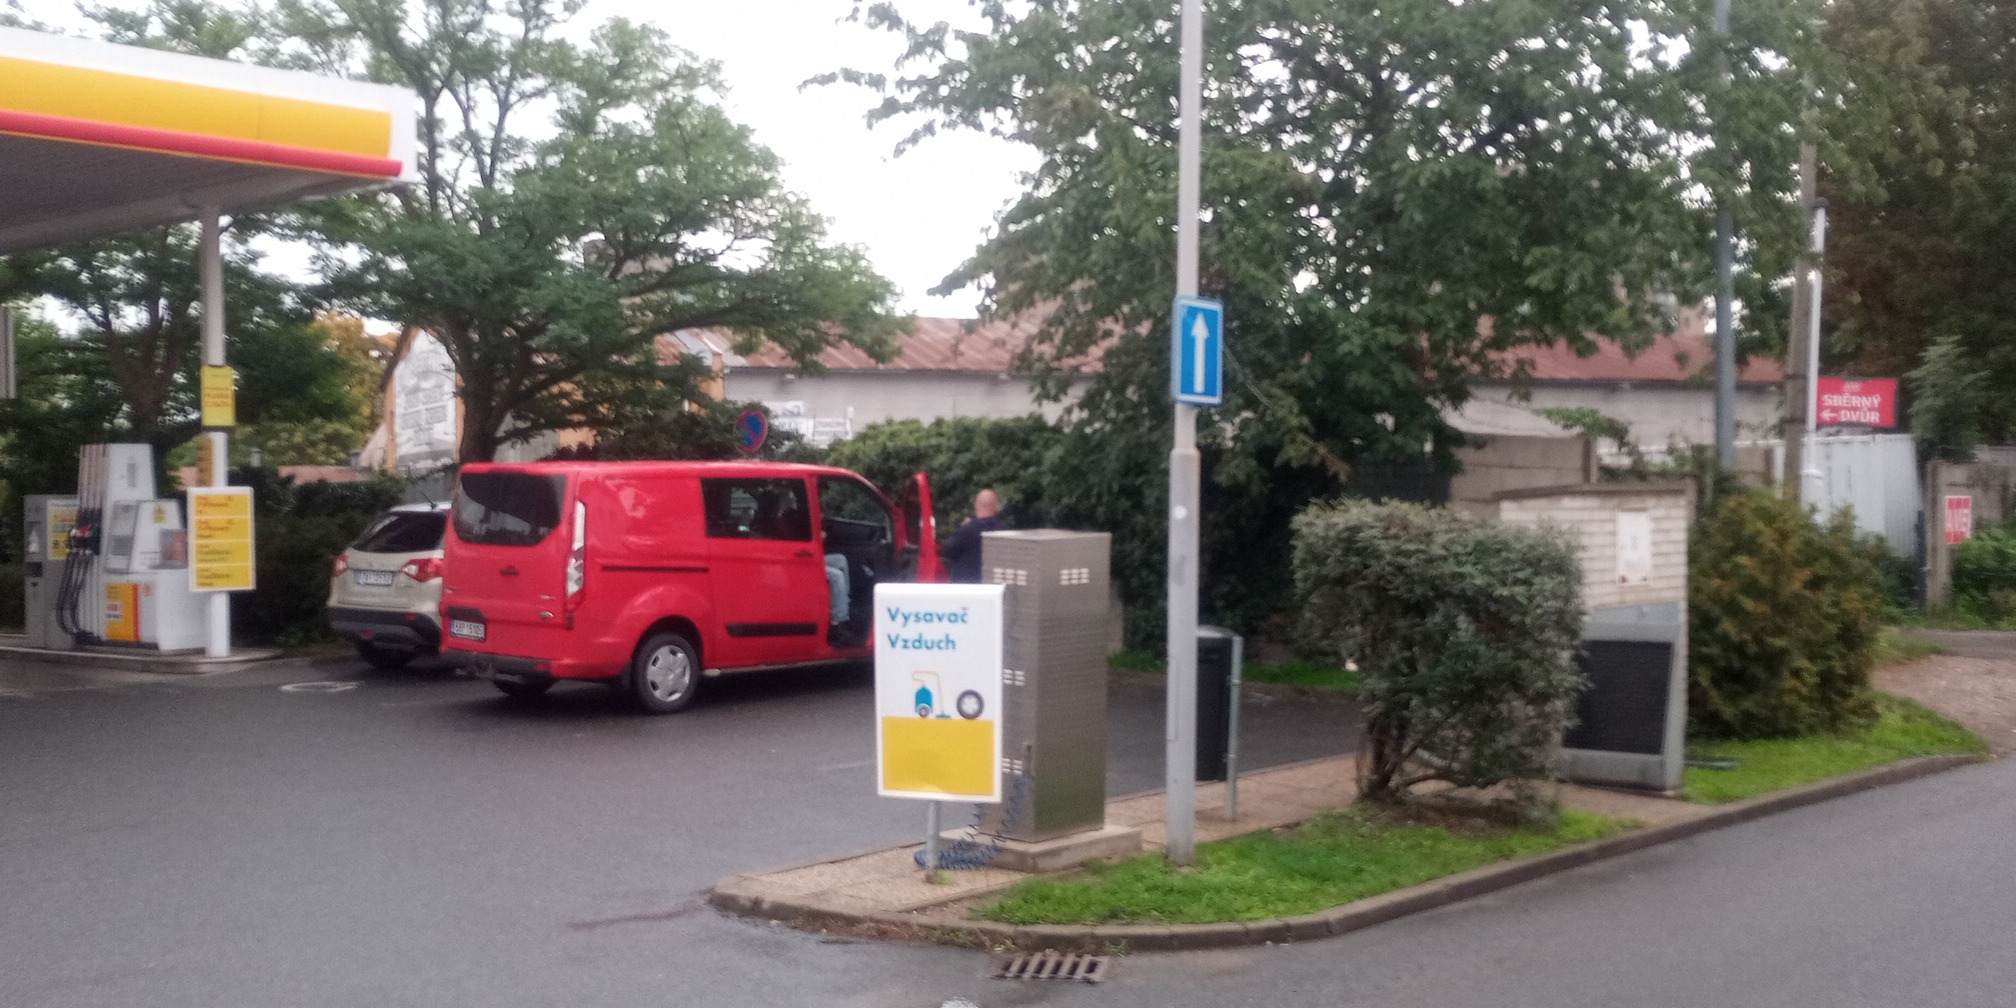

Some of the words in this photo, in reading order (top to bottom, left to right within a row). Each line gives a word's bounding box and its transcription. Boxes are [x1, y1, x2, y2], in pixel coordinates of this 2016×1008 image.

[1823, 392, 1881, 408] SBĚRNÝ
[1840, 408, 1880, 423] DVŮR
[887, 606, 969, 627] Vysavač
[887, 633, 957, 650] Vzduch
